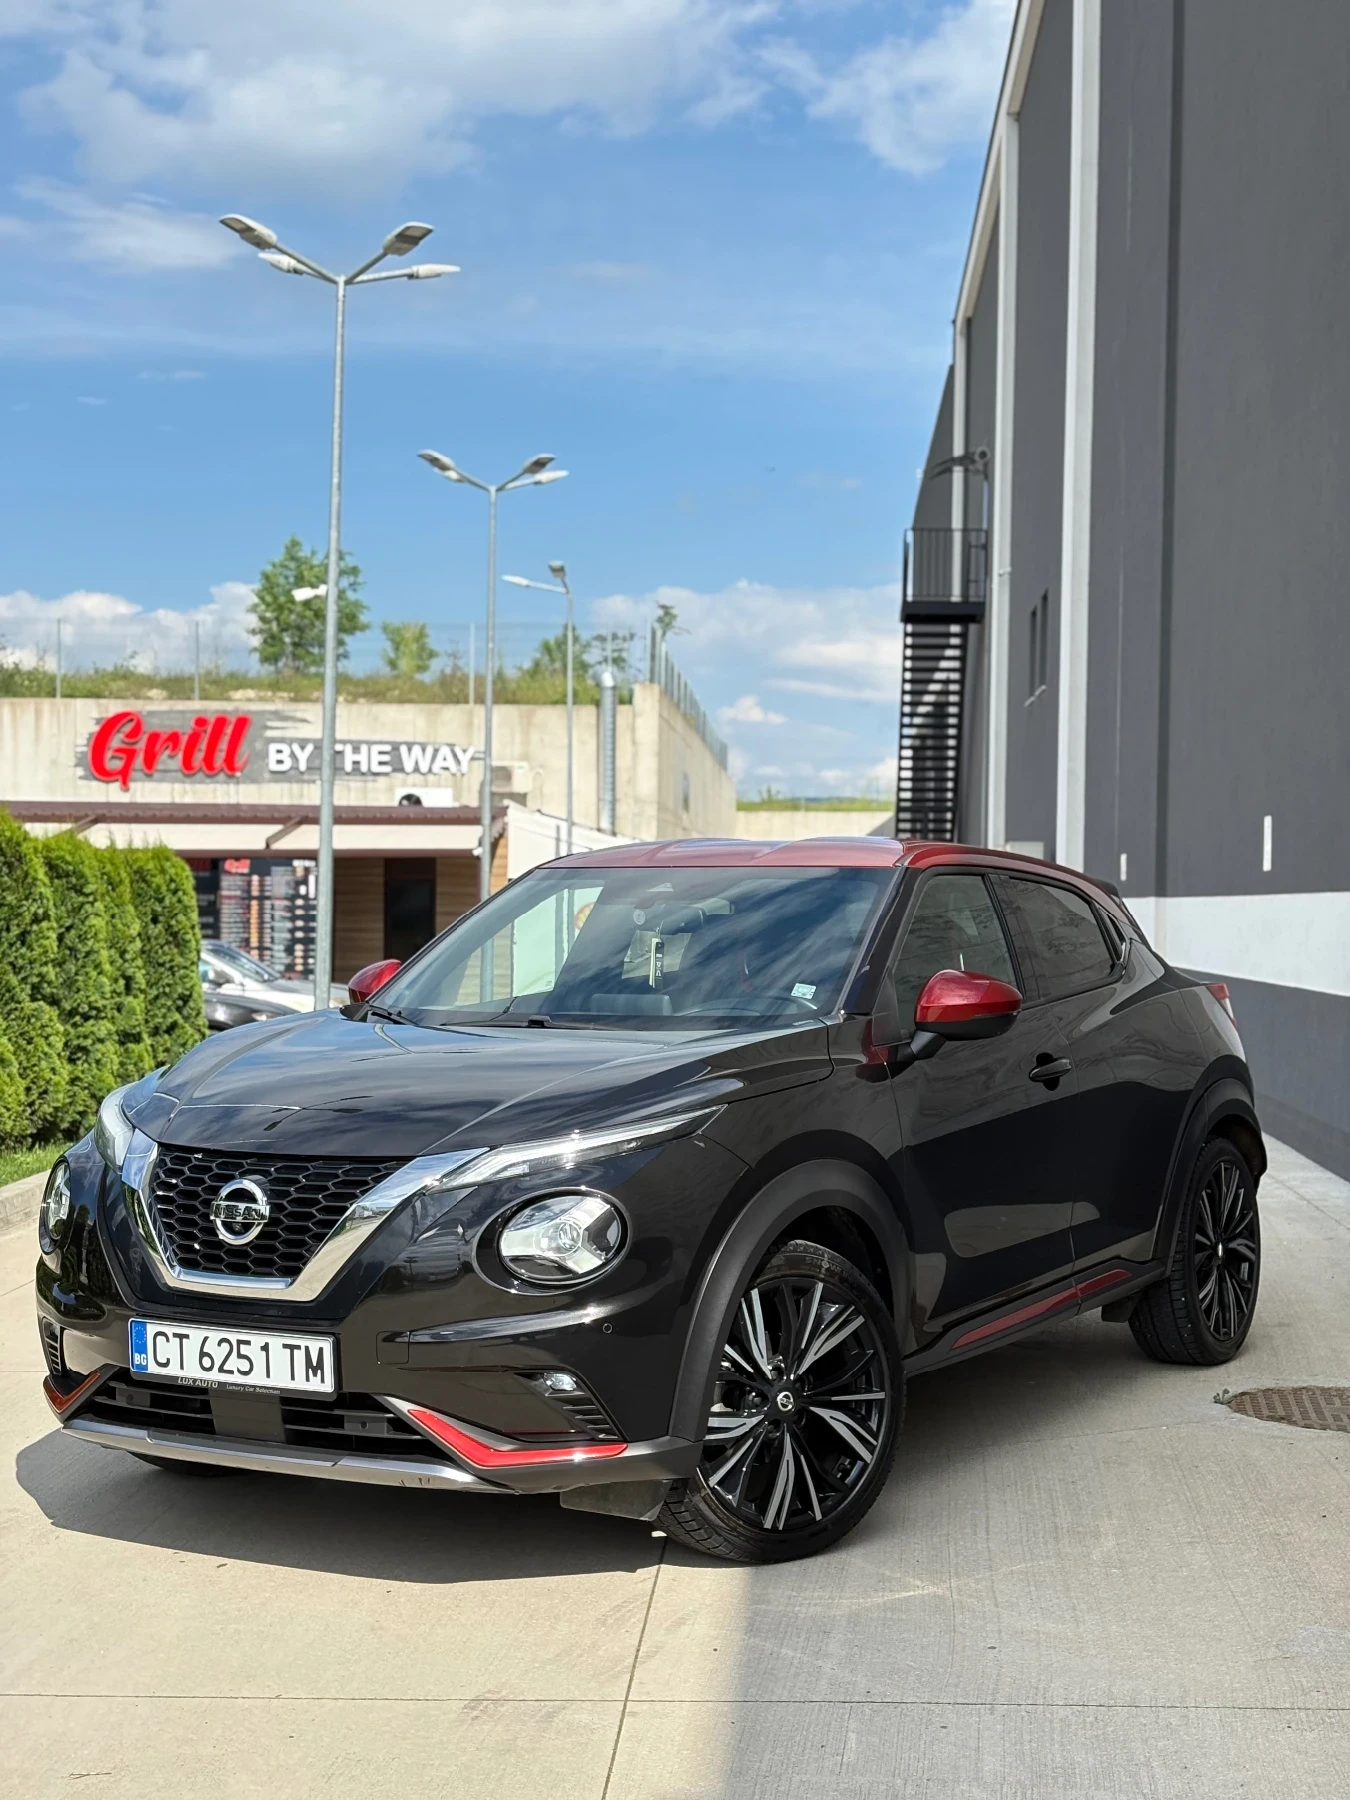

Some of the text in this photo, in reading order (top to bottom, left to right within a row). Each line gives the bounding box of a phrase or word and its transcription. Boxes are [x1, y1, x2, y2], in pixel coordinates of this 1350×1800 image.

[88, 710, 252, 791] Grill
[267, 742, 315, 772] BY
[399, 743, 476, 775] WAY
[213, 1203, 267, 1220] NISSAN
[134, 1353, 148, 1366] BG
[152, 1330, 326, 1385] CT 6251 TM
[177, 1377, 219, 1388] LUX AUTO
[226, 1383, 244, 1392] Luxury
[255, 1387, 281, 1395] Selection
